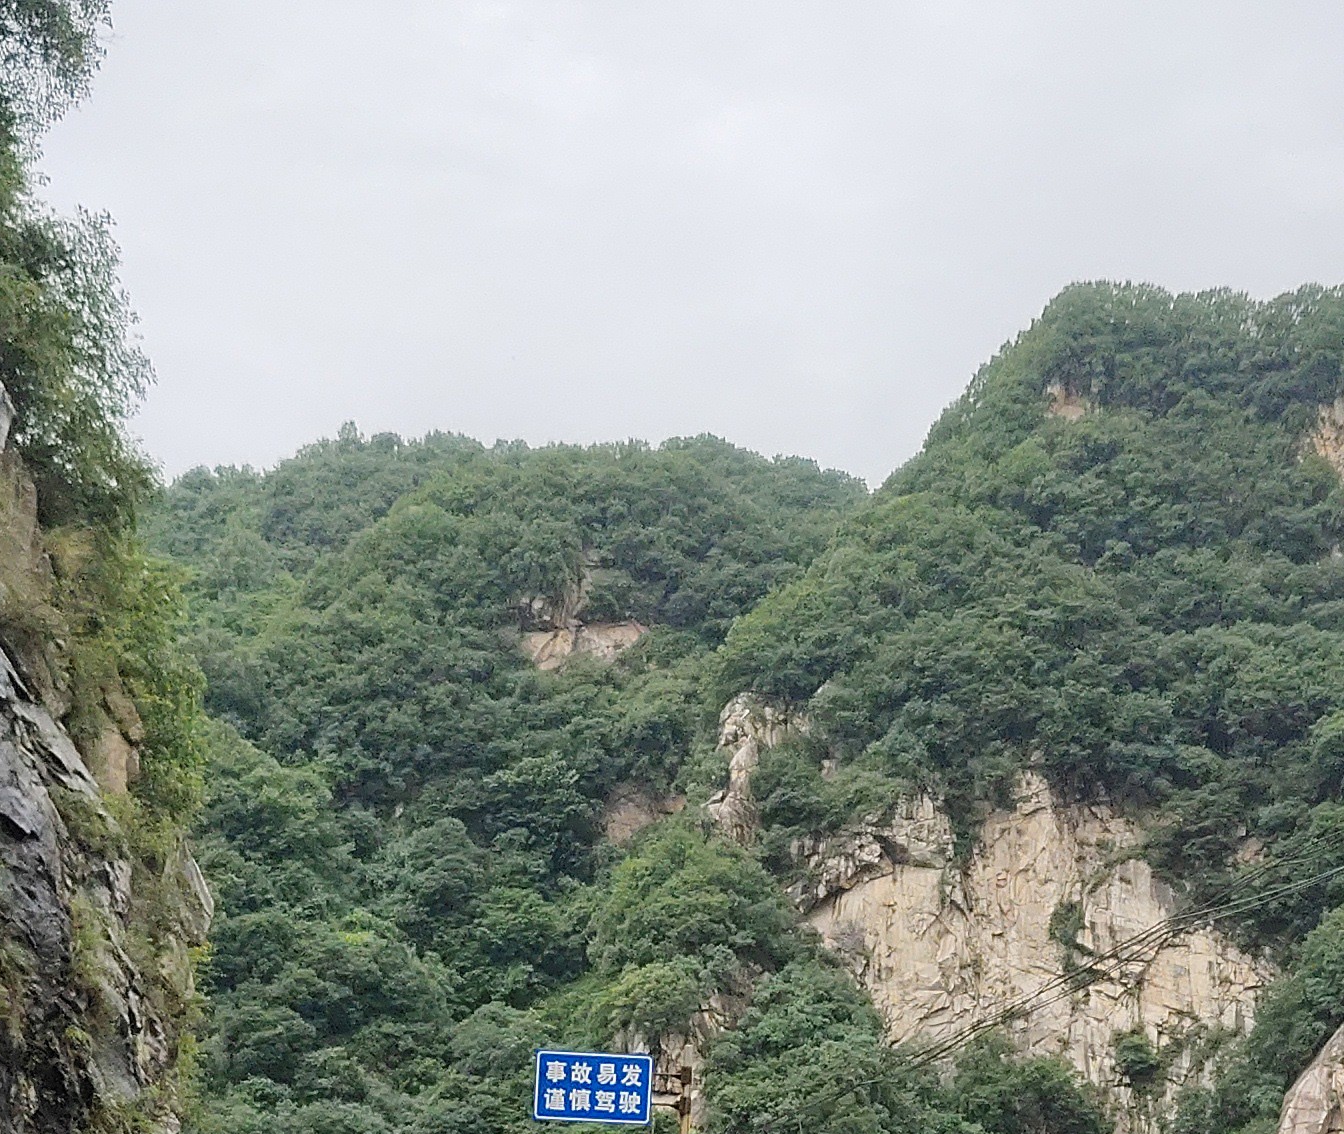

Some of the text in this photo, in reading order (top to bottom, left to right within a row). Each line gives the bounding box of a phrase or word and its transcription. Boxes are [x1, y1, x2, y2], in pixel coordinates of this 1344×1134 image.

[546, 1061, 642, 1087] 事故易发
[544, 1088, 641, 1114] 谨慎驾驶
